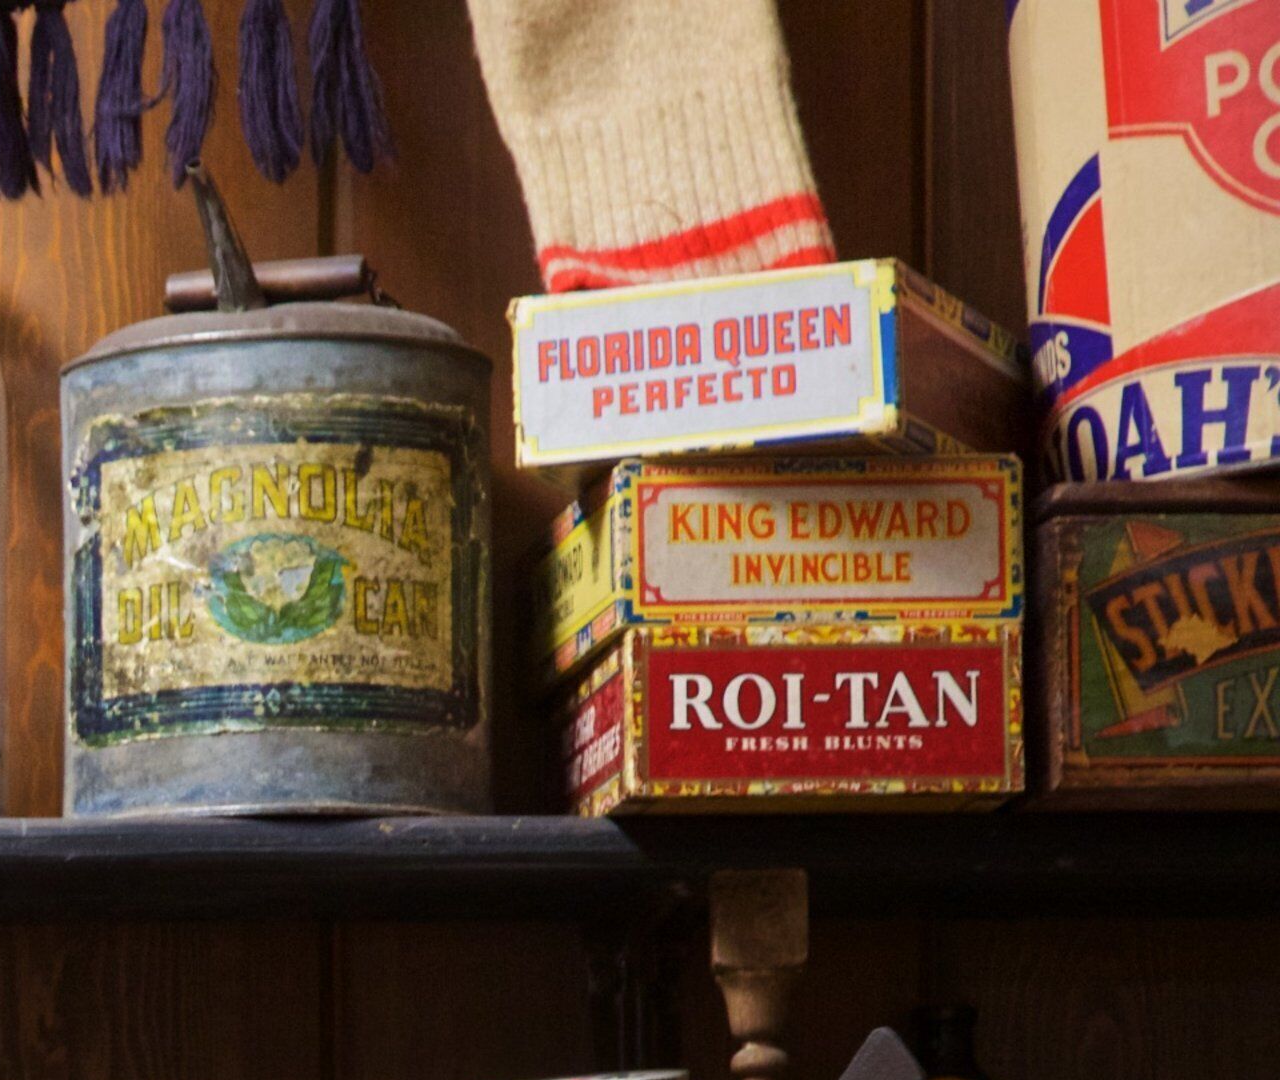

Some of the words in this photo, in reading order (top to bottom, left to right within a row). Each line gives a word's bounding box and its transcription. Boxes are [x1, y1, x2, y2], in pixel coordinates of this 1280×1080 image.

[538, 323, 701, 384] FLORIDA
[714, 302, 853, 368] QUEEN
[592, 364, 798, 420] PERFECTO
[122, 462, 434, 569] MAGNOLIA
[670, 502, 777, 545] KING
[789, 499, 972, 541] EDWARD
[731, 551, 913, 587] INVINCIBLE
[116, 580, 196, 646] OIL
[352, 575, 439, 640] CAN
[1105, 545, 1280, 674] STICK
[669, 670, 979, 731] ROI-TAN
[726, 736, 809, 752] FRESH
[825, 735, 924, 751] BLUNTS
